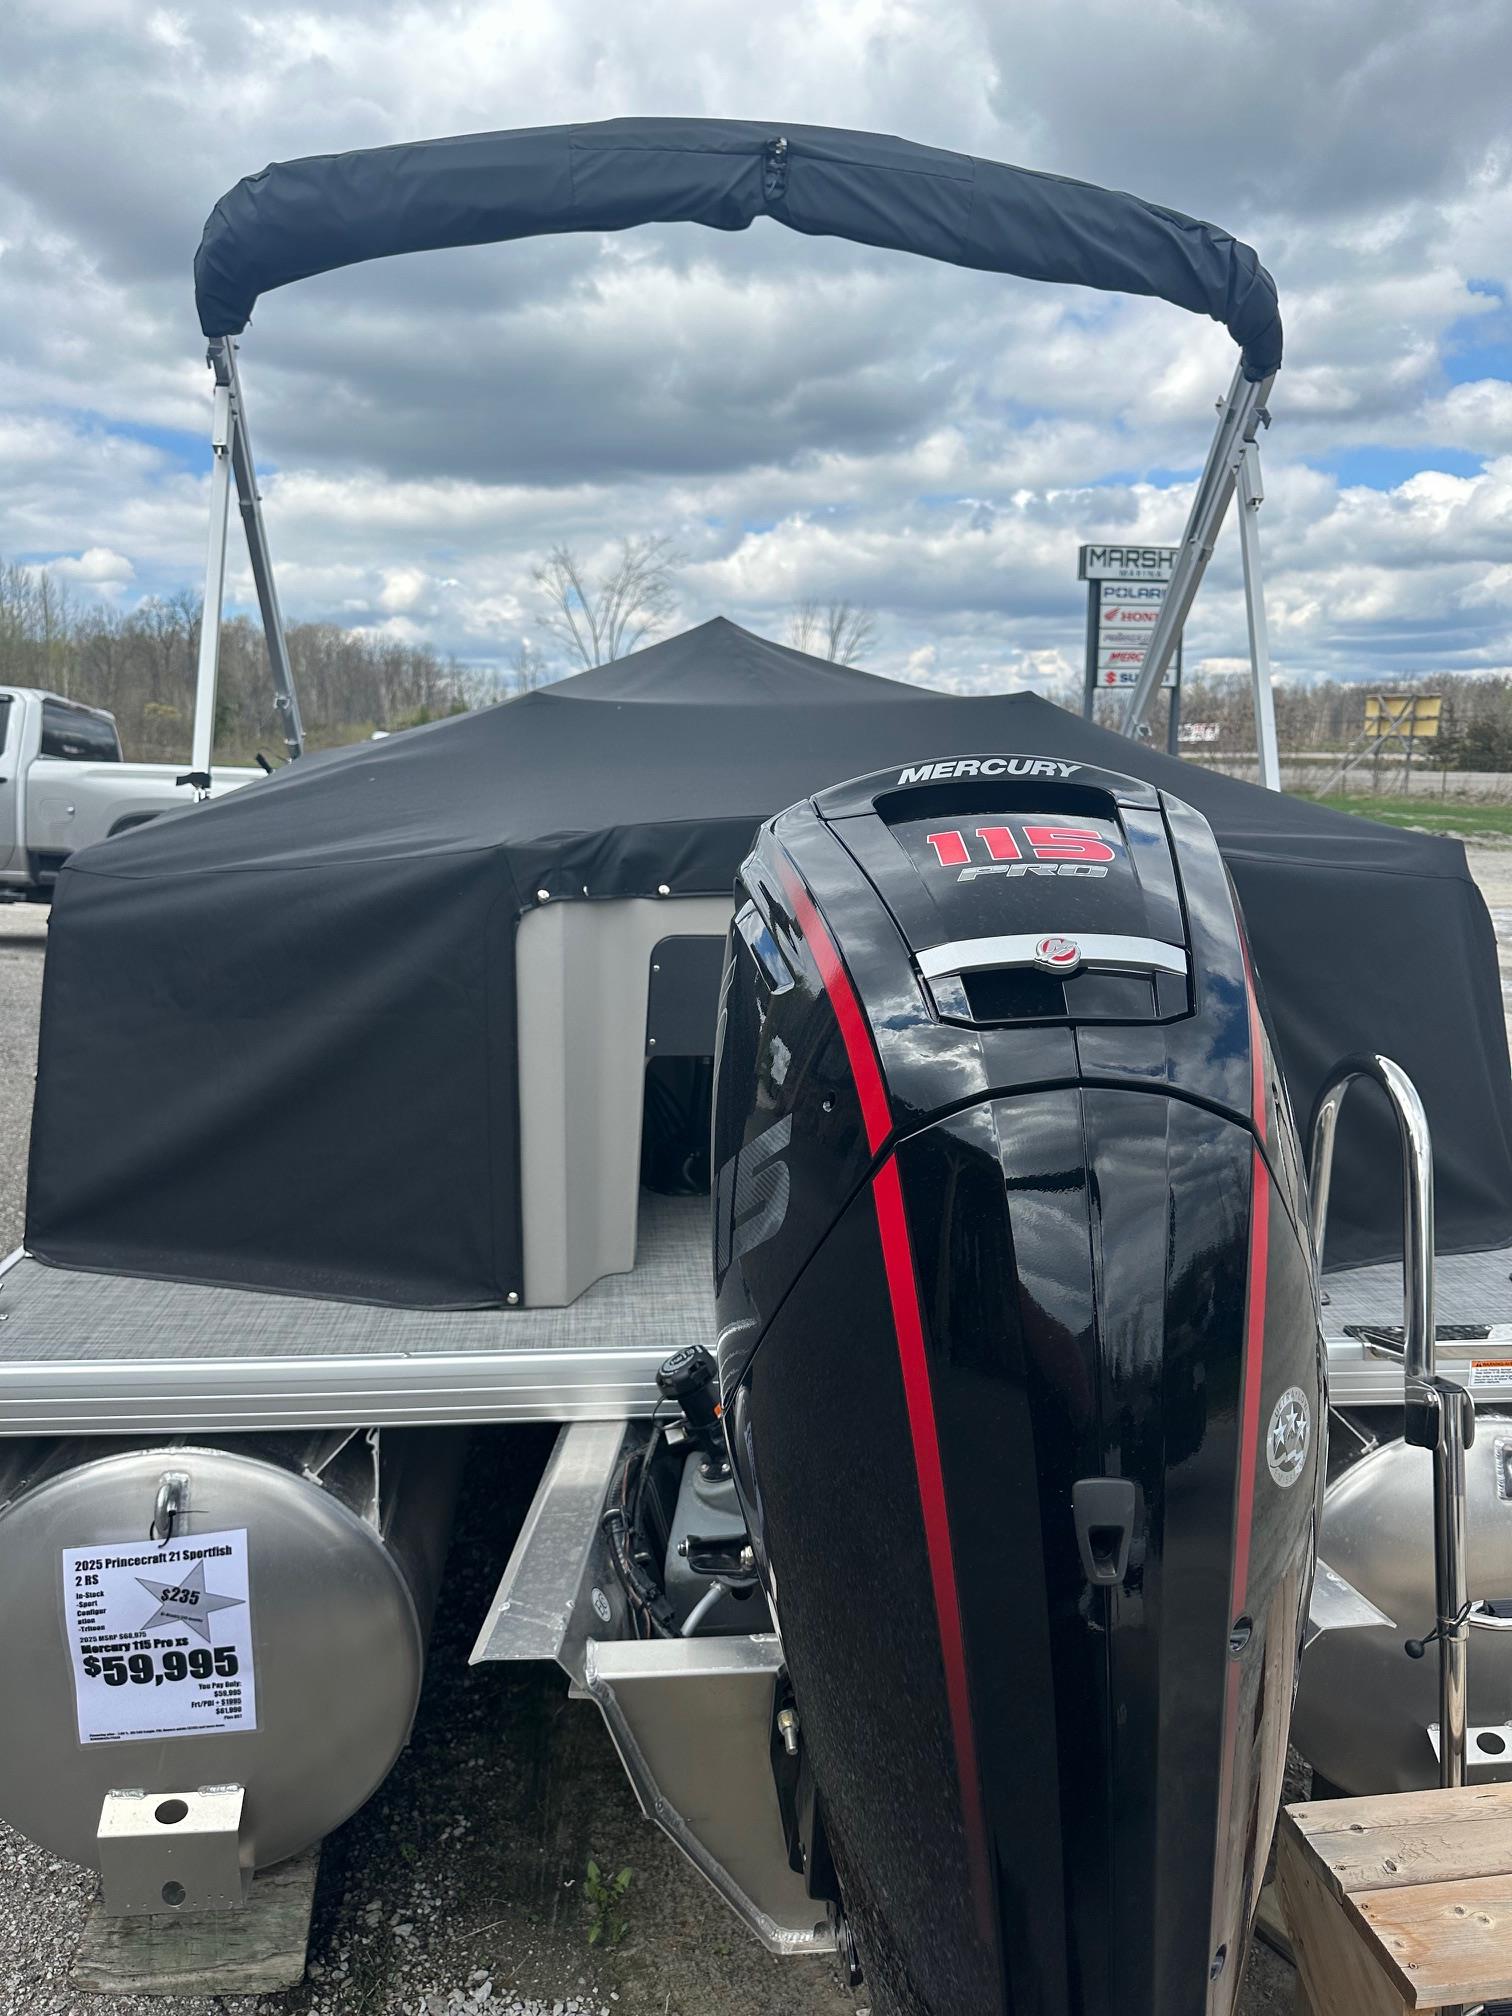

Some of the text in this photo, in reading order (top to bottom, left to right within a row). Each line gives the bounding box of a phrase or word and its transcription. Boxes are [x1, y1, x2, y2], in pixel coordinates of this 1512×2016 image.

[1104, 587, 1167, 598] POLAR
[897, 758, 1082, 785] MERCURY
[926, 826, 1116, 867] 115
[957, 863, 1109, 882] PRO
[75, 1545, 232, 1572] 2025 Princecraft 21 Sportfish
[75, 1574, 99, 1587] 2 RS
[76, 1590, 104, 1599] In-Stock
[161, 1587, 200, 1605] $235
[81, 1637, 189, 1654] Mercury 115 Pro xs
[82, 1646, 238, 1687] $59,995
